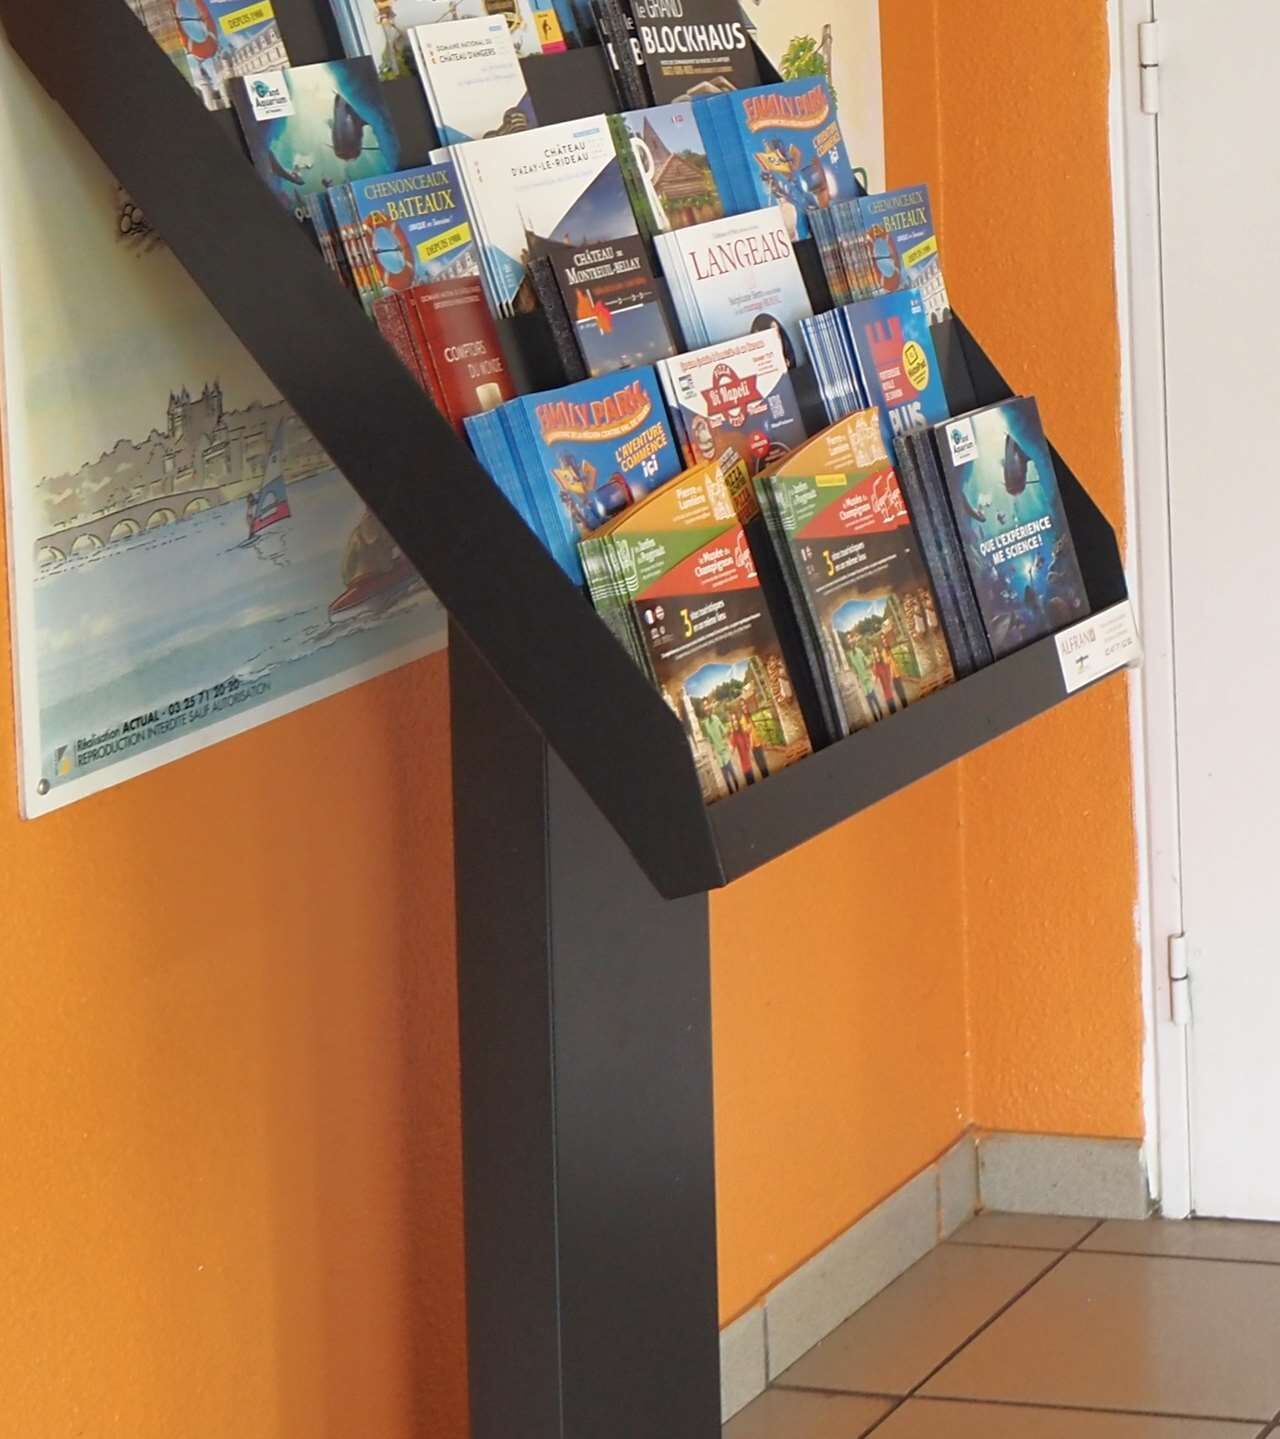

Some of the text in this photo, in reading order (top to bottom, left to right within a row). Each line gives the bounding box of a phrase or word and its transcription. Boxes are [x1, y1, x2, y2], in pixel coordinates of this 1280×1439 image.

[641, 22, 746, 54] BLOCKHAUS
[512, 153, 589, 176] D'AZAY-LE-RIDEAU
[544, 142, 586, 158] CHÂTEAU
[364, 170, 450, 200] CHENONCEAUX
[387, 189, 456, 220] BATEAUX
[867, 192, 923, 214] CHENONCEAUX
[882, 207, 927, 232] BATEAUX
[574, 247, 614, 266] CHÂTEAU
[689, 228, 792, 280] LANGEAIS
[615, 422, 663, 462] L'AVENTURE
[621, 433, 667, 472] COMMENCE
[642, 454, 658, 478] ici
[980, 516, 1052, 557] QUE L'EXPÉRIENCE
[823, 550, 835, 576] 3
[992, 539, 1038, 565] ME SCIENCE
[680, 608, 693, 638] 3
[77, 682, 271, 767] REPRODUCTION INTERDITE SAUF AUTORISATION
[122, 712, 160, 734] ACTUAL
[168, 704, 181, 716] 03
[184, 698, 196, 710] 25
